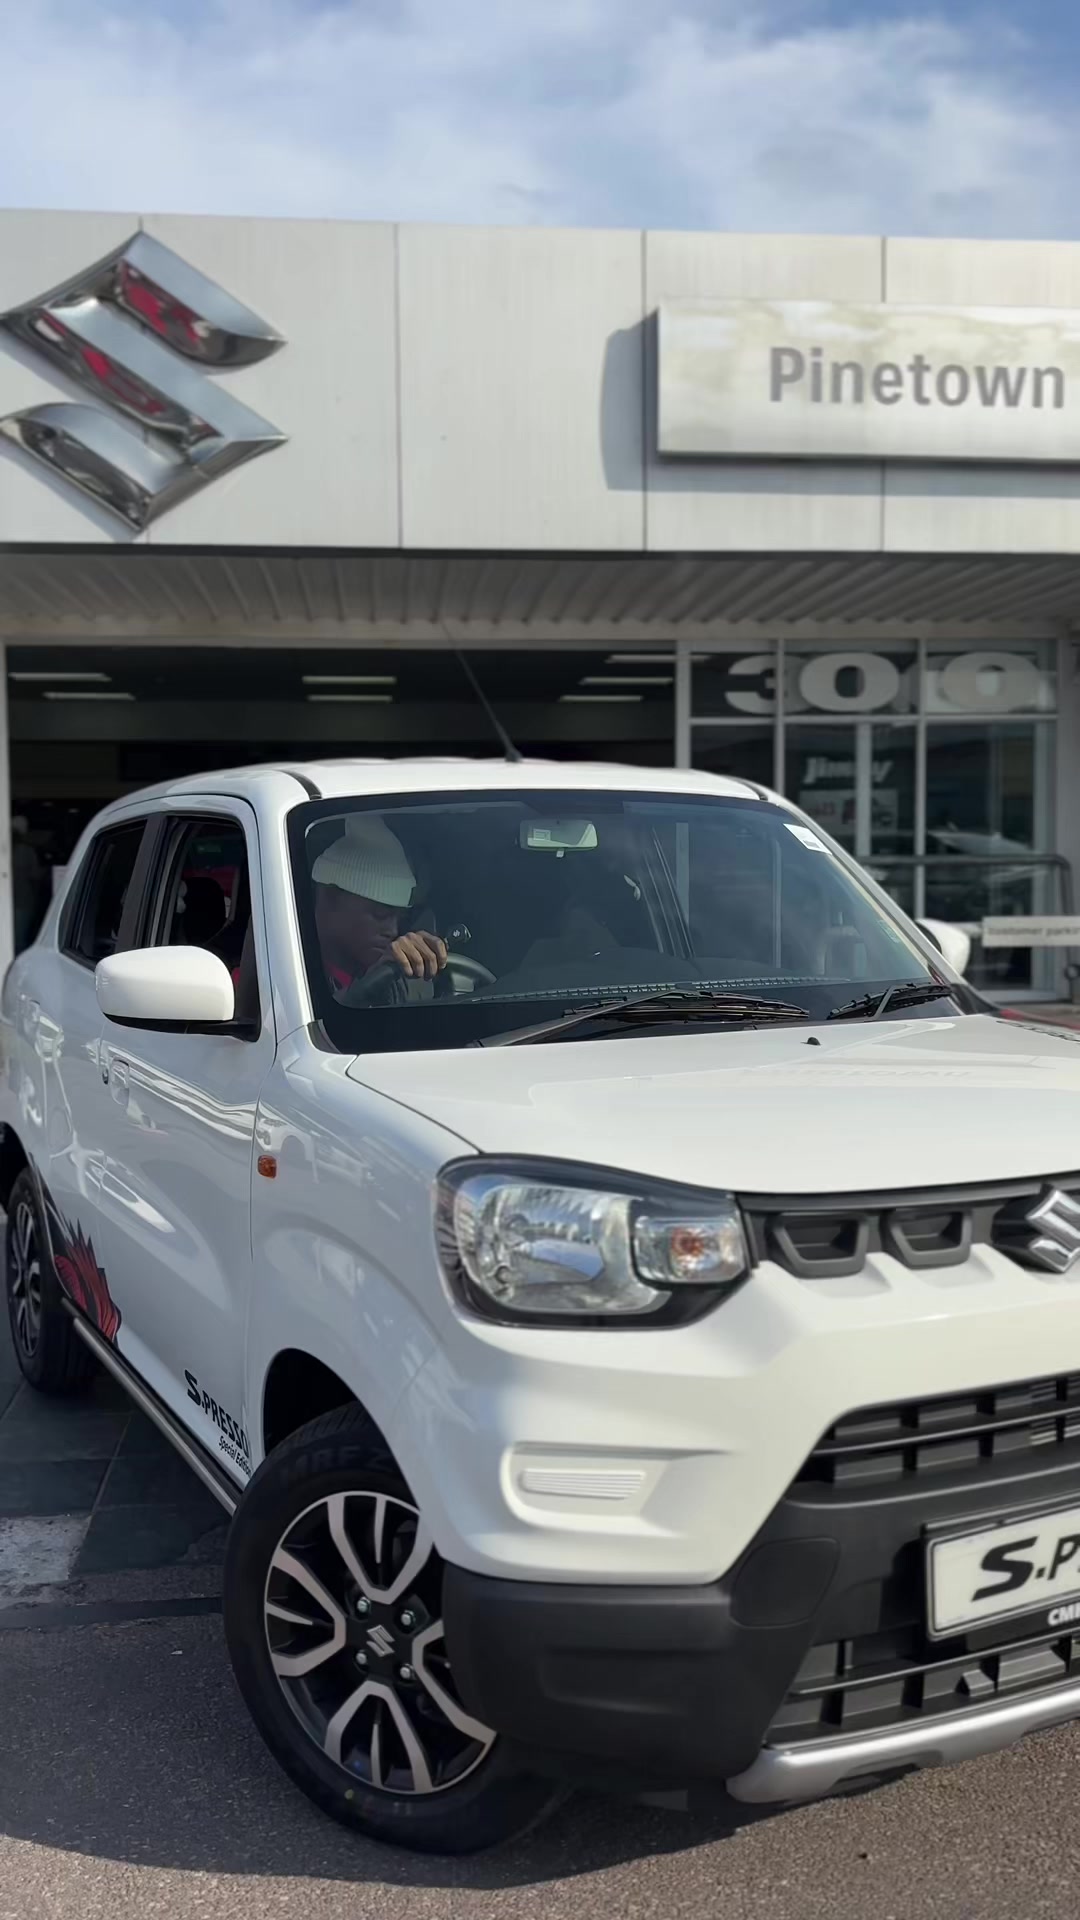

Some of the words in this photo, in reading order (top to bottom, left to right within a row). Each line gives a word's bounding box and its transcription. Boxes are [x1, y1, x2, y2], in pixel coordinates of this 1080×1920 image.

[769, 346, 1065, 409] Pinetown
[184, 1369, 250, 1459] S.PRESSO
[218, 1435, 238, 1461] Special
[970, 1533, 1080, 1602] S.P
